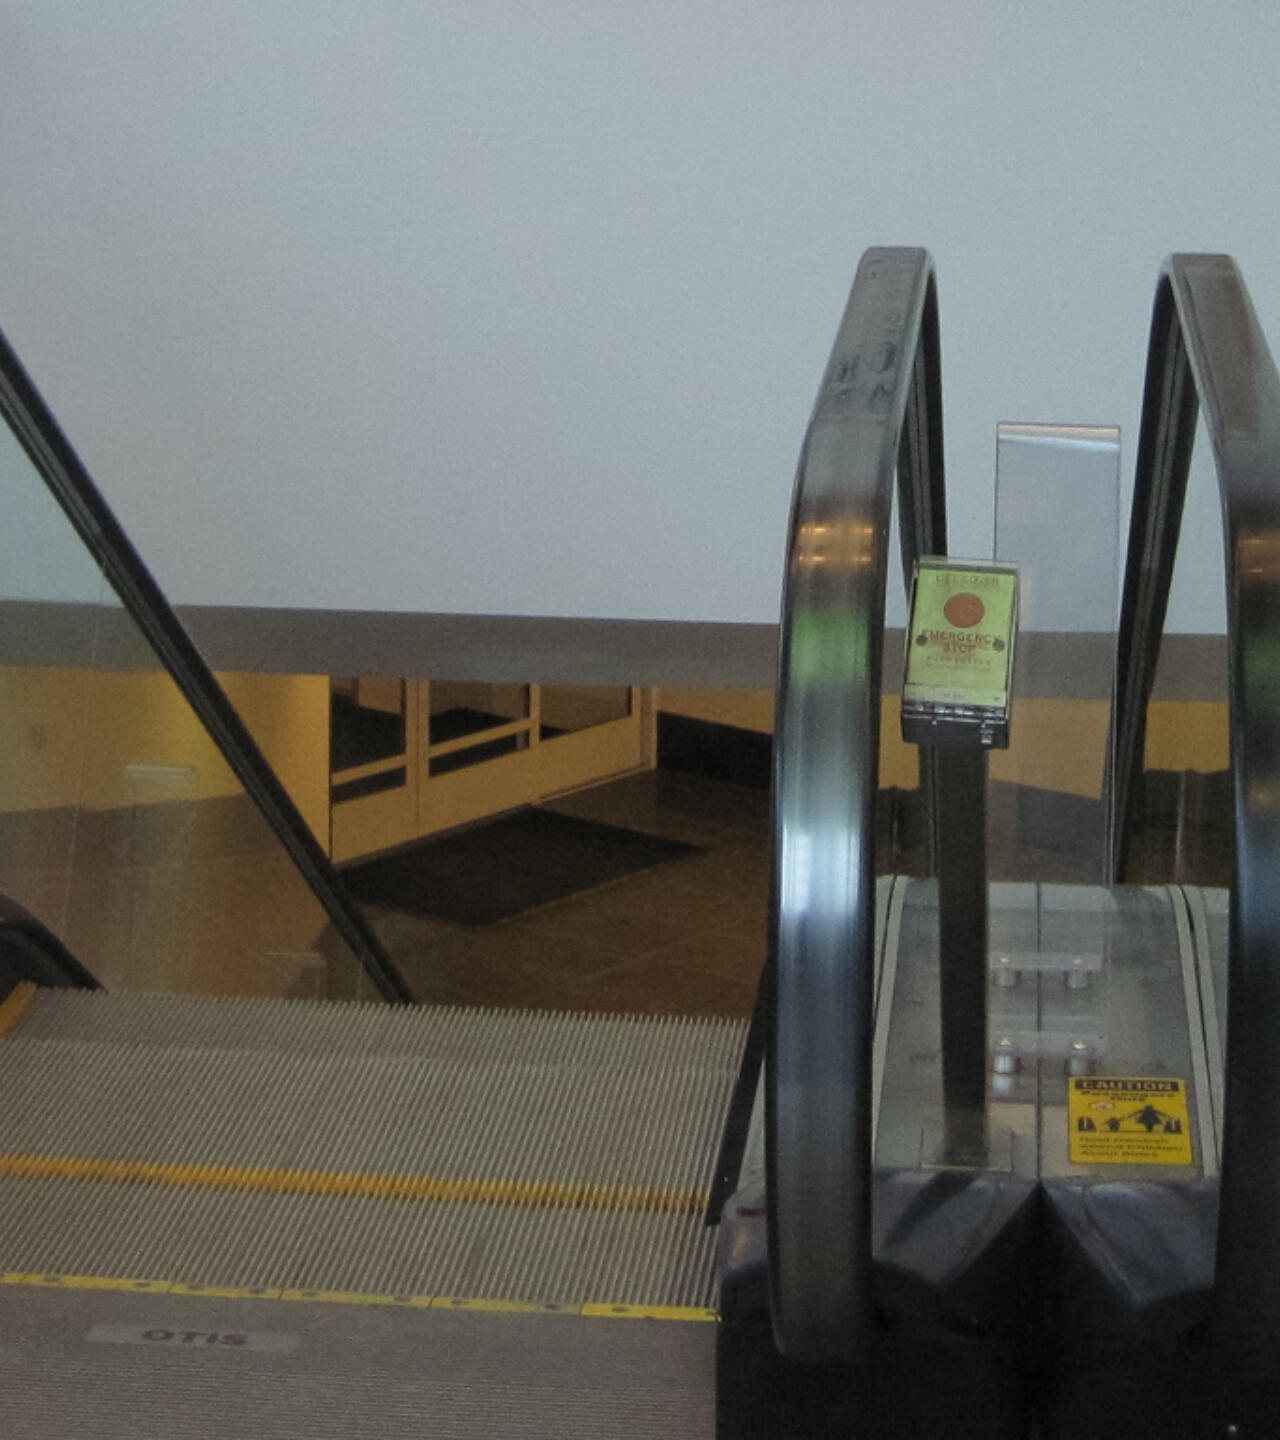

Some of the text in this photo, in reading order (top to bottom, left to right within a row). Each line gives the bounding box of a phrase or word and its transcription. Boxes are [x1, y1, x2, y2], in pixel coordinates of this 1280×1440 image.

[943, 642, 977, 654] STOP
[1081, 1079, 1172, 1091] CAUTION
[142, 1328, 249, 1345] OTIS
